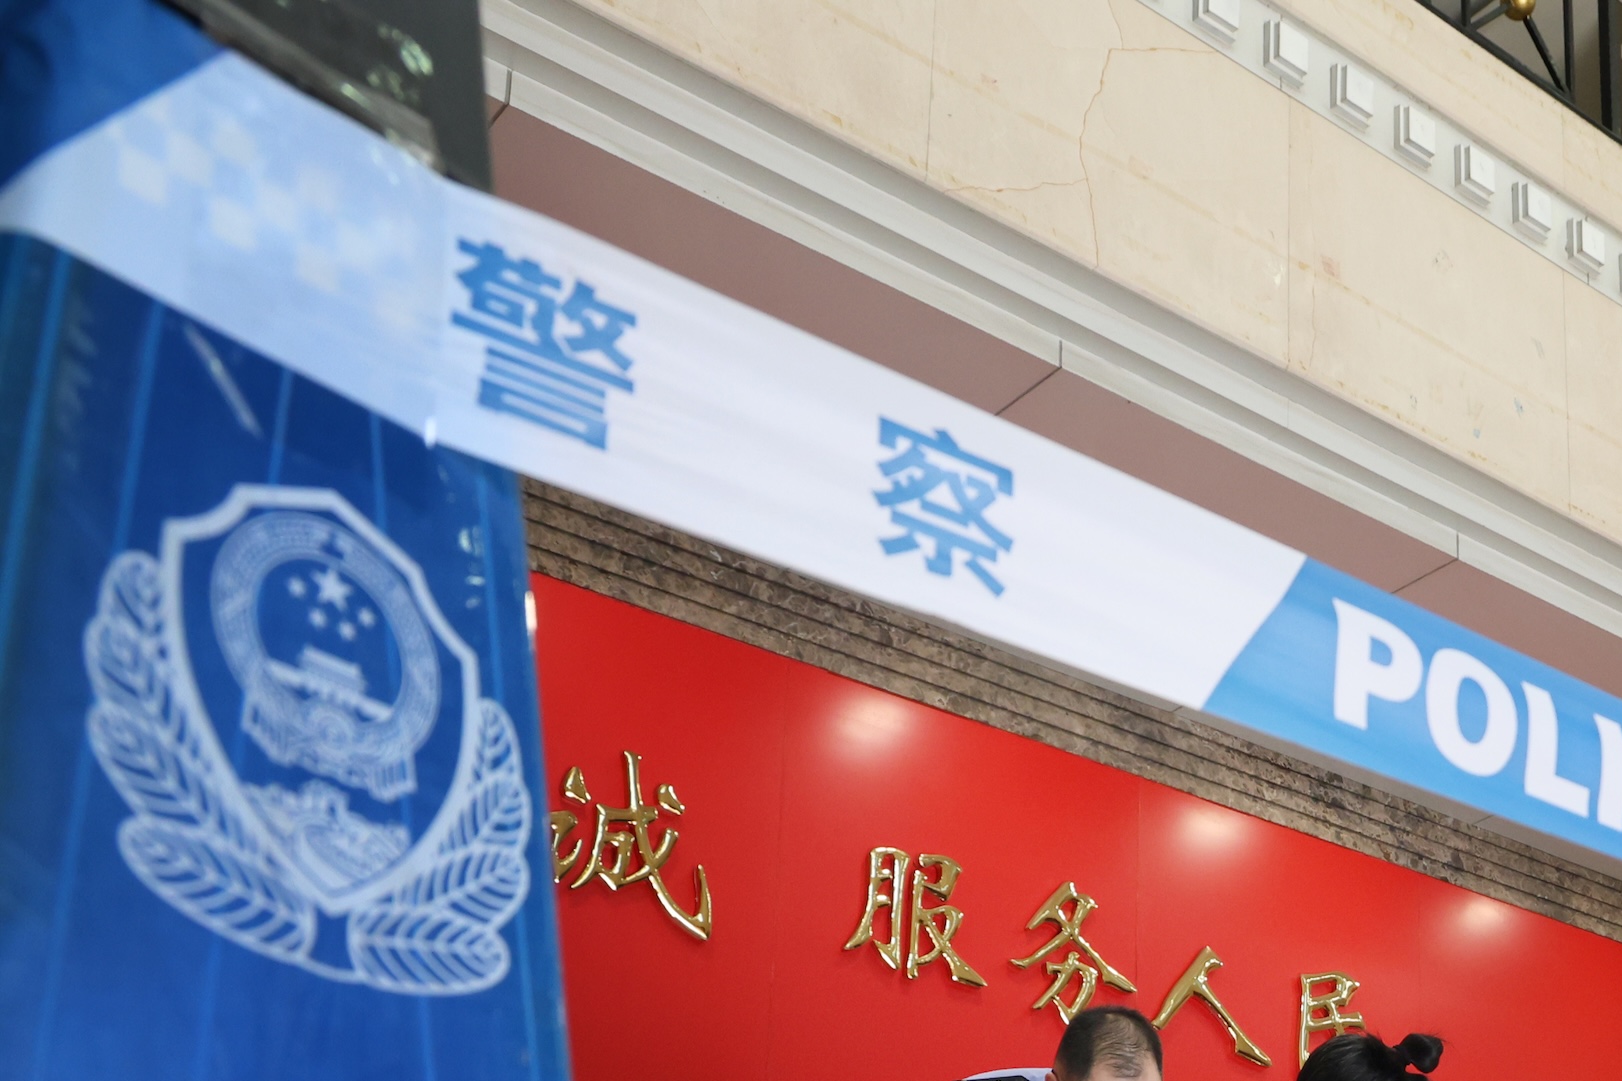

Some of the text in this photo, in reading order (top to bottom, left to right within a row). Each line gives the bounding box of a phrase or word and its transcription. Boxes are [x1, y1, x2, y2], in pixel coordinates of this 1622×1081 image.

[450, 237, 1014, 598] 警察
[843, 846, 1366, 1068] 服务人民
